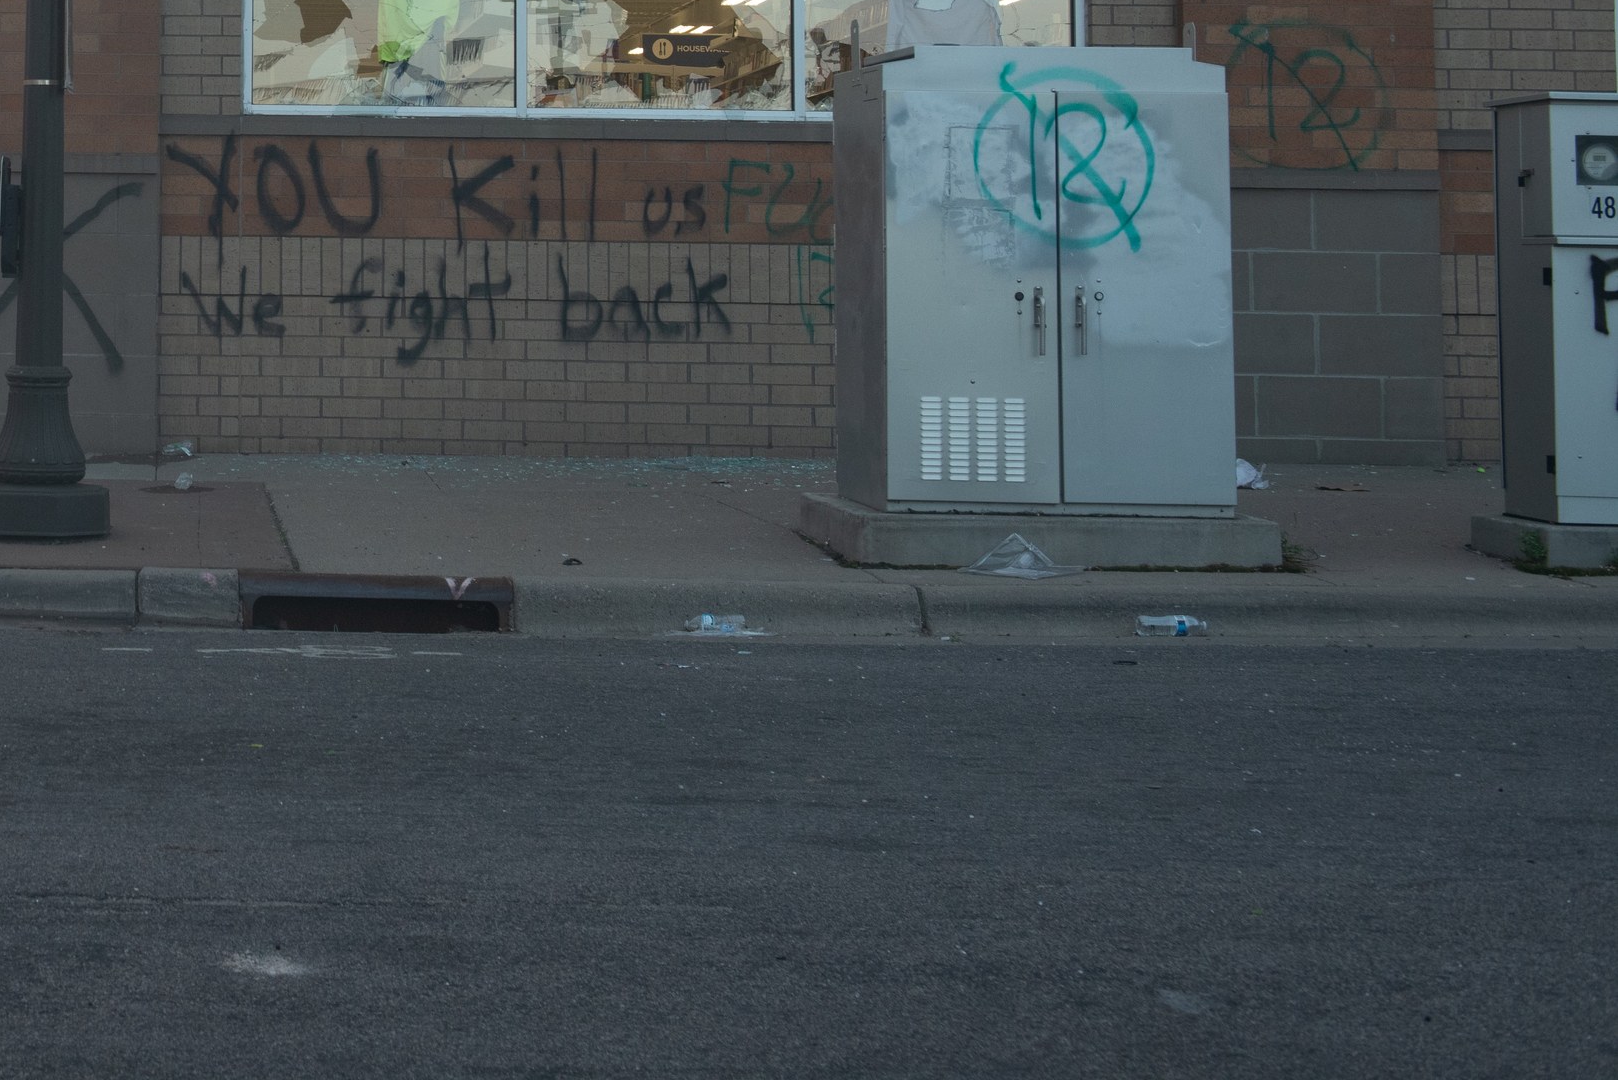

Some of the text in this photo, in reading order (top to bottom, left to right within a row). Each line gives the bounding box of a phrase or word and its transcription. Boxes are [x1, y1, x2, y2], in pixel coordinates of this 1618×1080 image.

[166, 130, 707, 265] YOU Kill us
[1591, 196, 1617, 220] 48
[182, 240, 732, 367] We fight back
